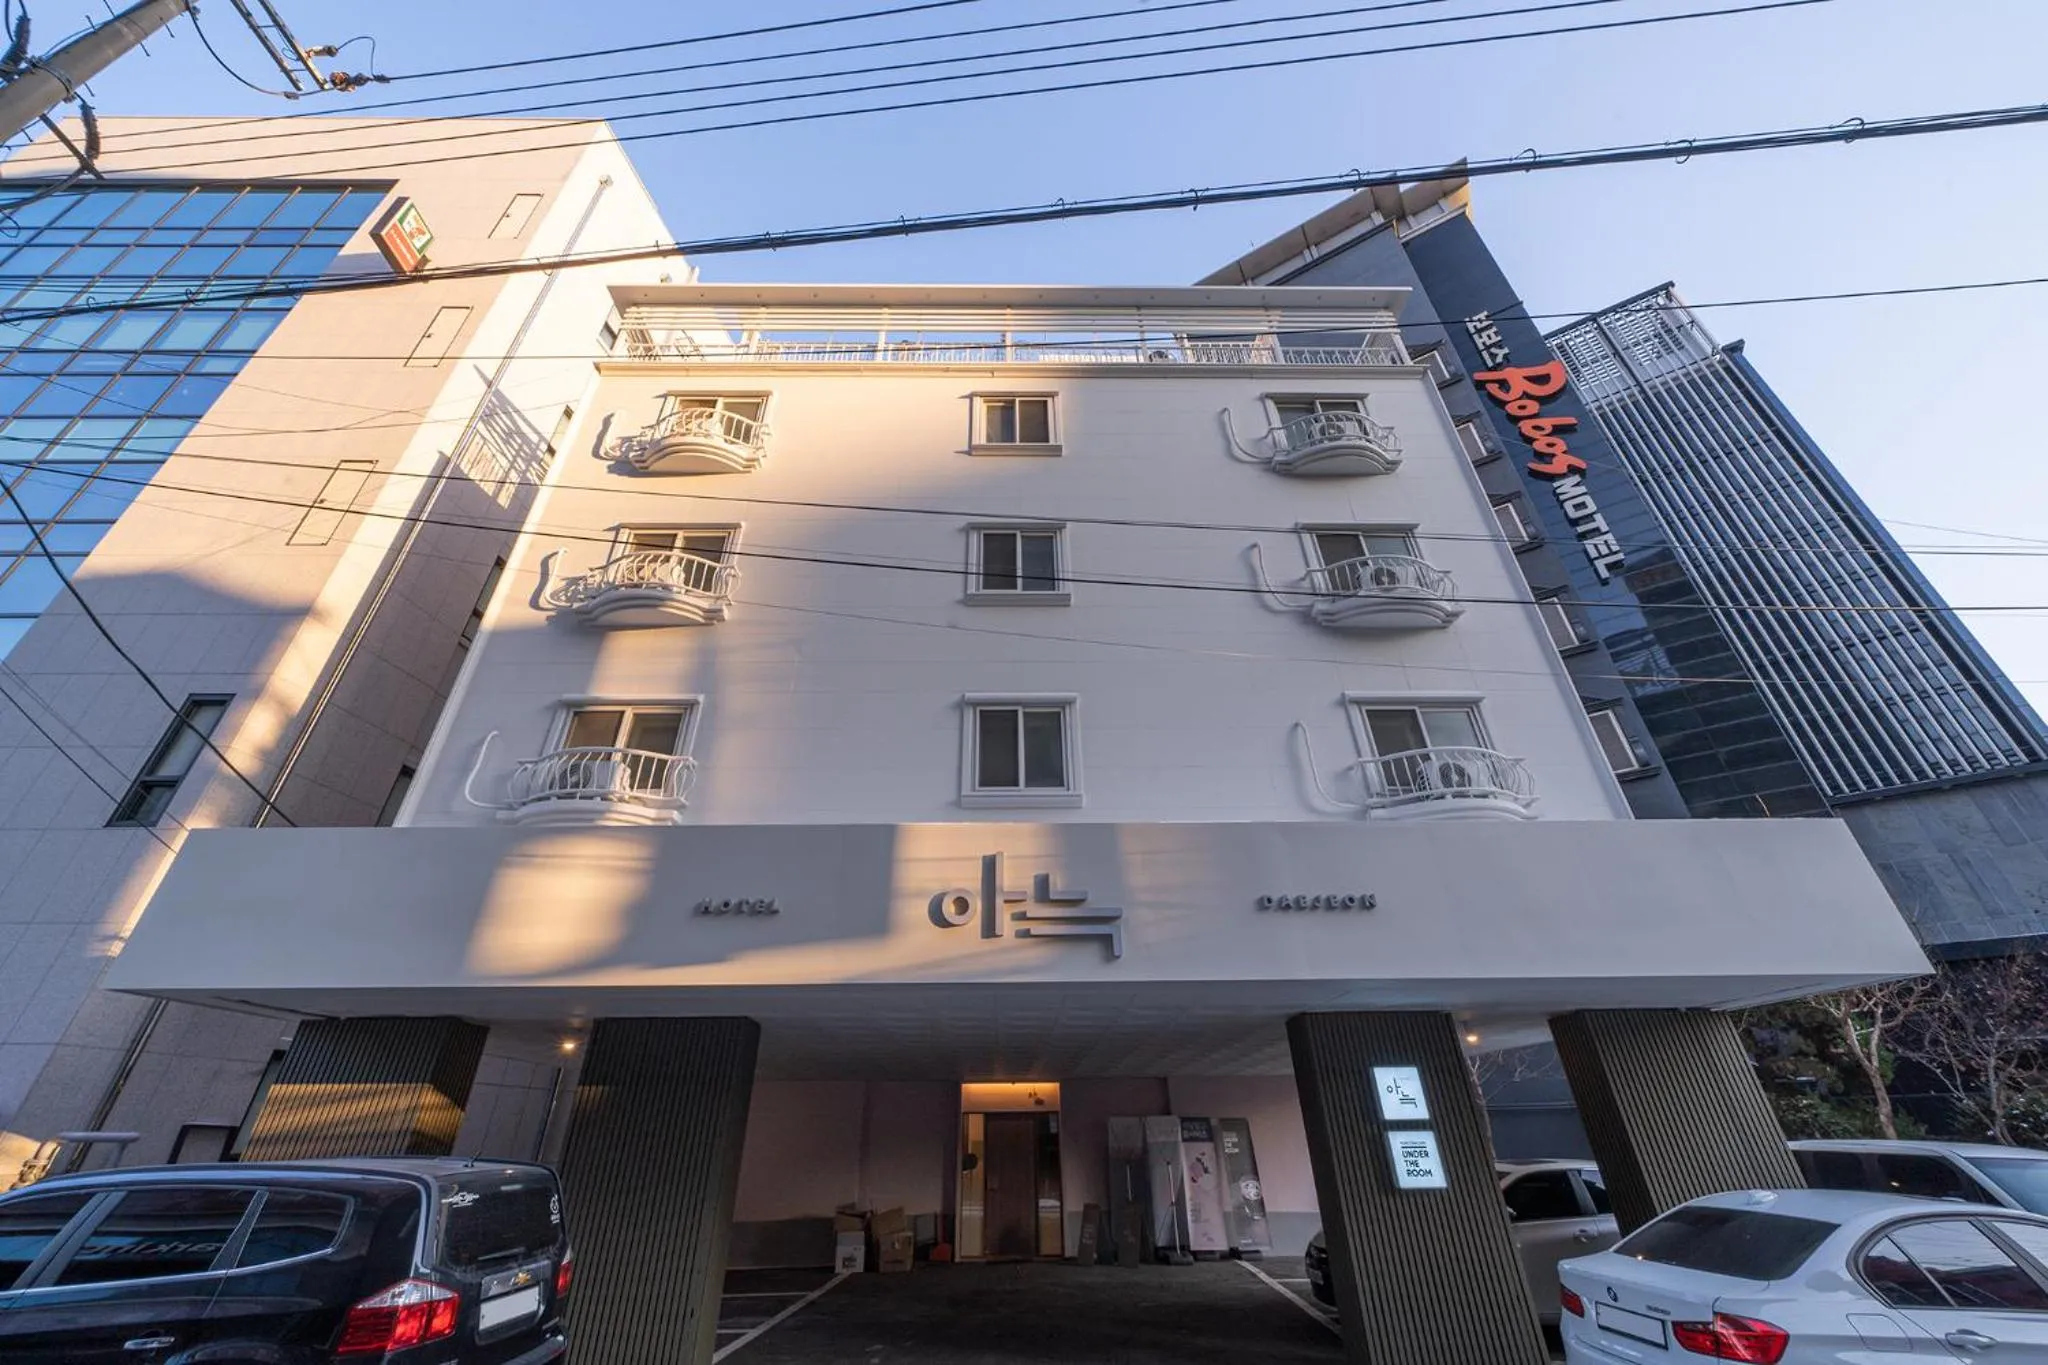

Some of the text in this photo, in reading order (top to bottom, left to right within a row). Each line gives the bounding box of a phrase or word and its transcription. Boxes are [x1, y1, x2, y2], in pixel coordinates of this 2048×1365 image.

[1465, 310, 1511, 369] 보보스
[1473, 359, 1588, 475] Bobos
[1552, 475, 1626, 580] MOTEL
[696, 897, 782, 916] HOTEL
[930, 851, 1124, 960] 아늑
[1255, 894, 1377, 911] DAEJEON
[1386, 1077, 1418, 1108] 아늑
[1401, 1150, 1429, 1158] UNDER
[1404, 1159, 1420, 1168] THE
[1406, 1168, 1433, 1178] ROOM
